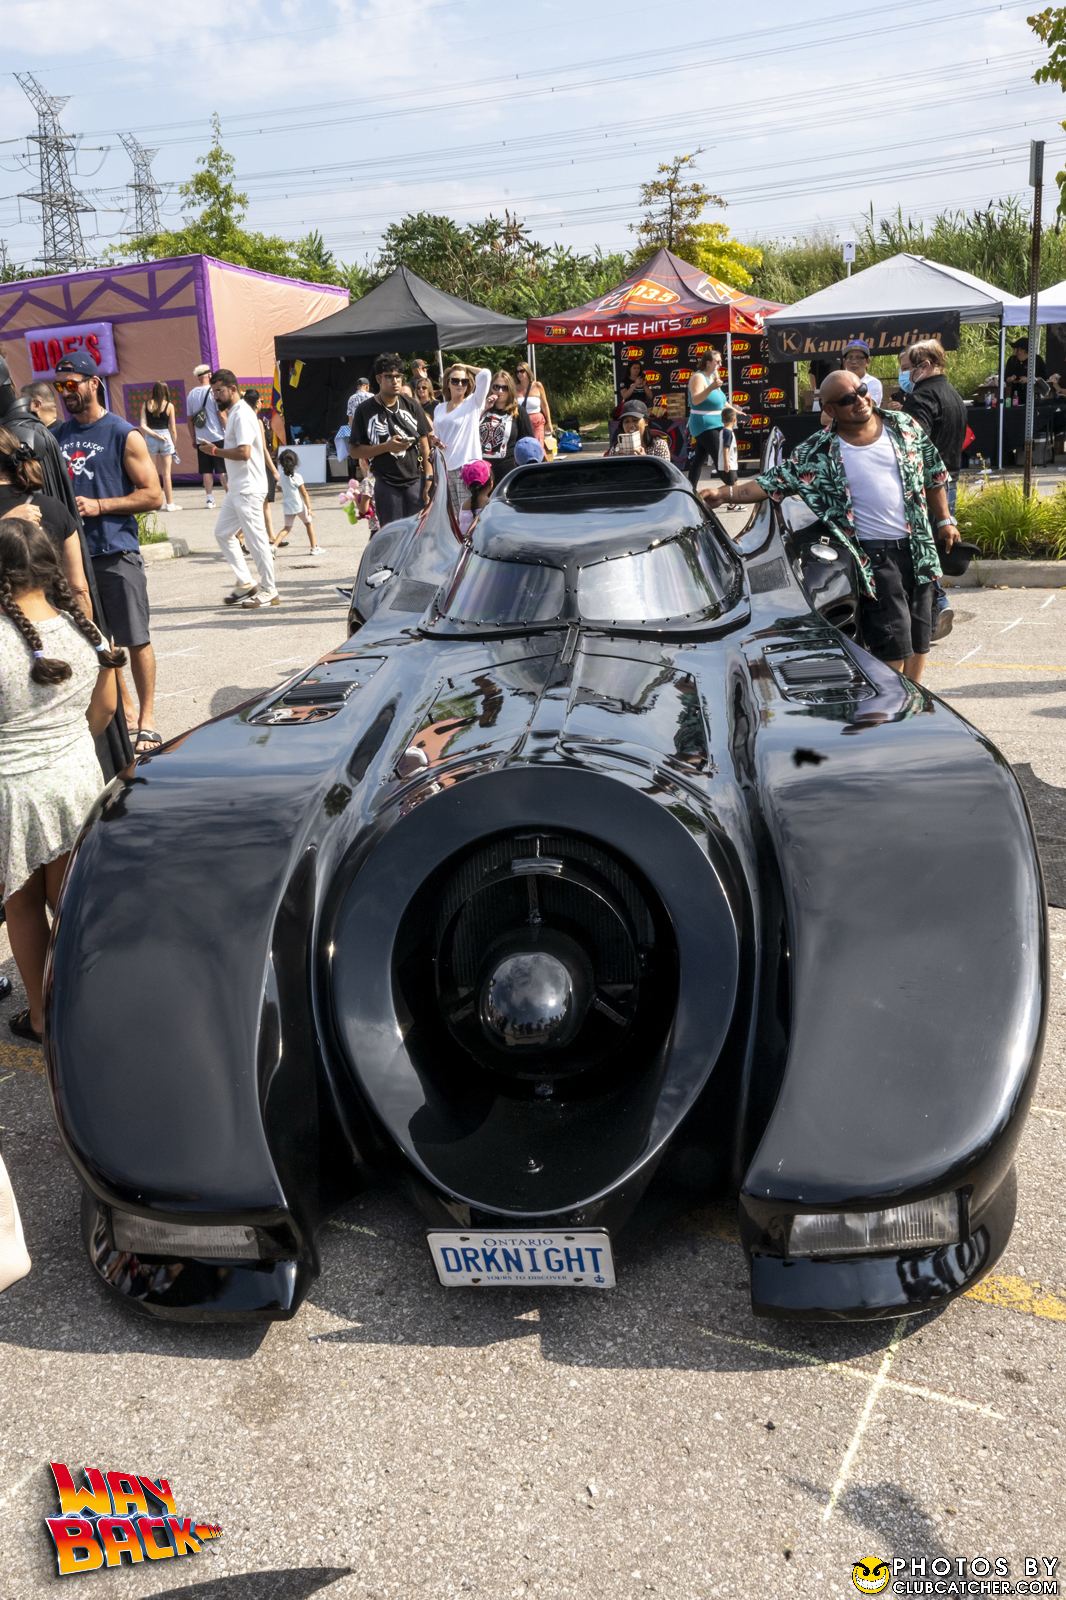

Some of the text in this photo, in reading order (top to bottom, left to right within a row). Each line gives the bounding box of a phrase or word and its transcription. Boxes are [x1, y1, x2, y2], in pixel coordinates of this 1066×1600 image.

[572, 325, 603, 337] ALL
[607, 322, 640, 336] THE
[642, 318, 682, 334] HITS
[803, 331, 875, 353] Kama
[483, 1238, 554, 1247] ONTARIO
[440, 1247, 603, 1273] DRKNIGHT
